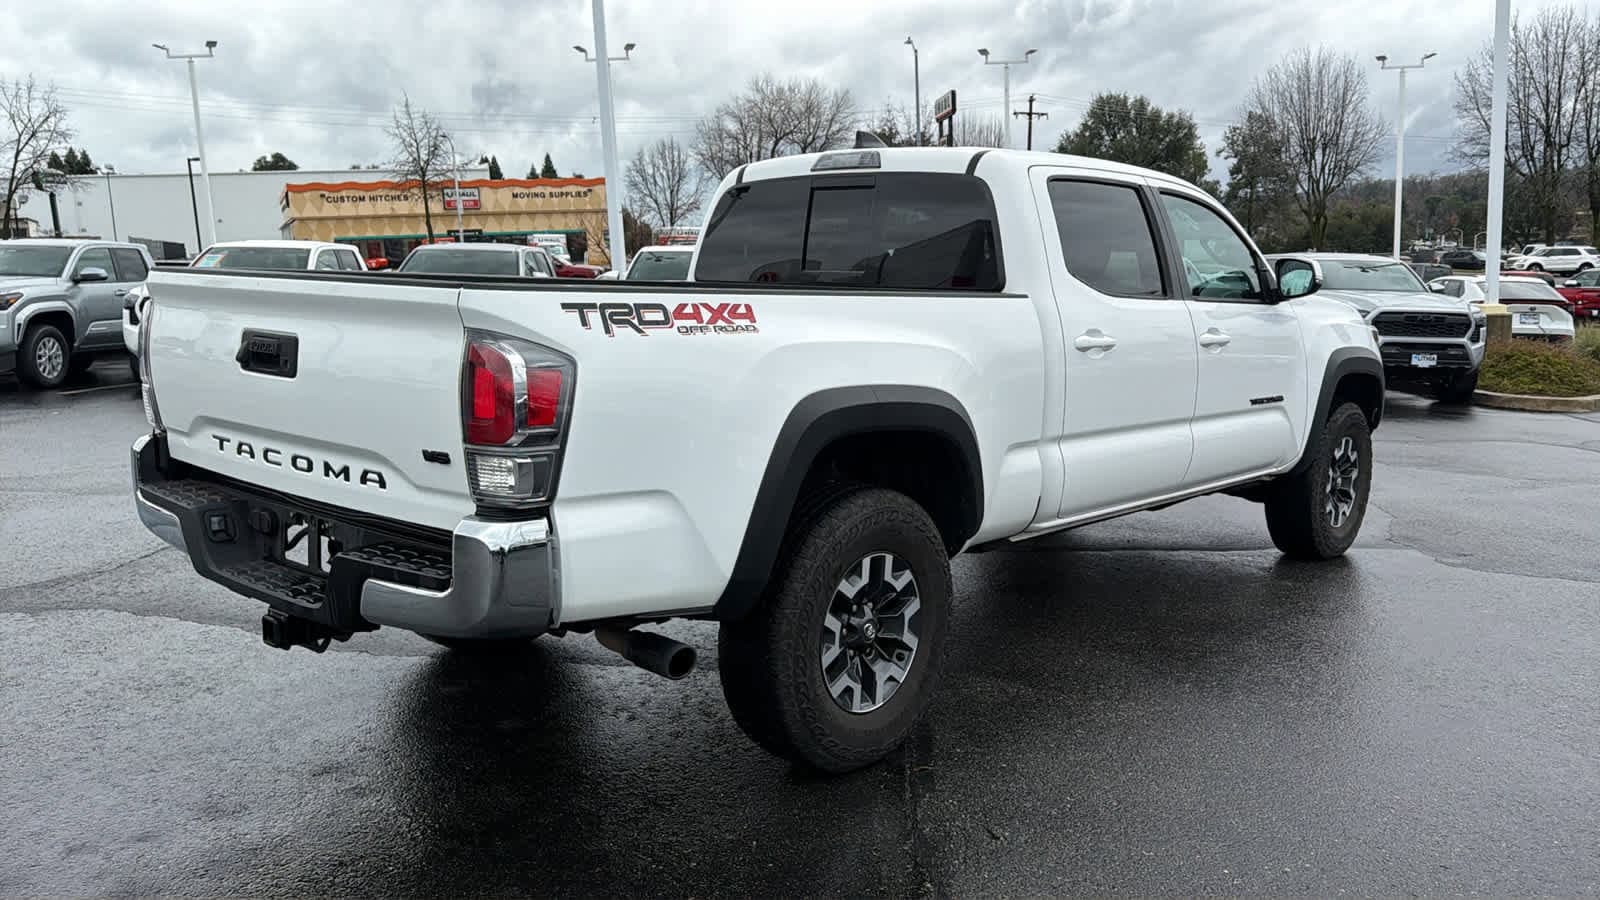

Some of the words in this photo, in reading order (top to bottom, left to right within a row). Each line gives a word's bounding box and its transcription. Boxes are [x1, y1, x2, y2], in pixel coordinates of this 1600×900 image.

[369, 194, 409, 203] HITCHES
[512, 191, 546, 199] MOVING
[560, 302, 674, 338] TRD
[677, 325, 711, 335] OFF
[713, 325, 760, 334] ROAD
[212, 433, 387, 489] TACOMA
